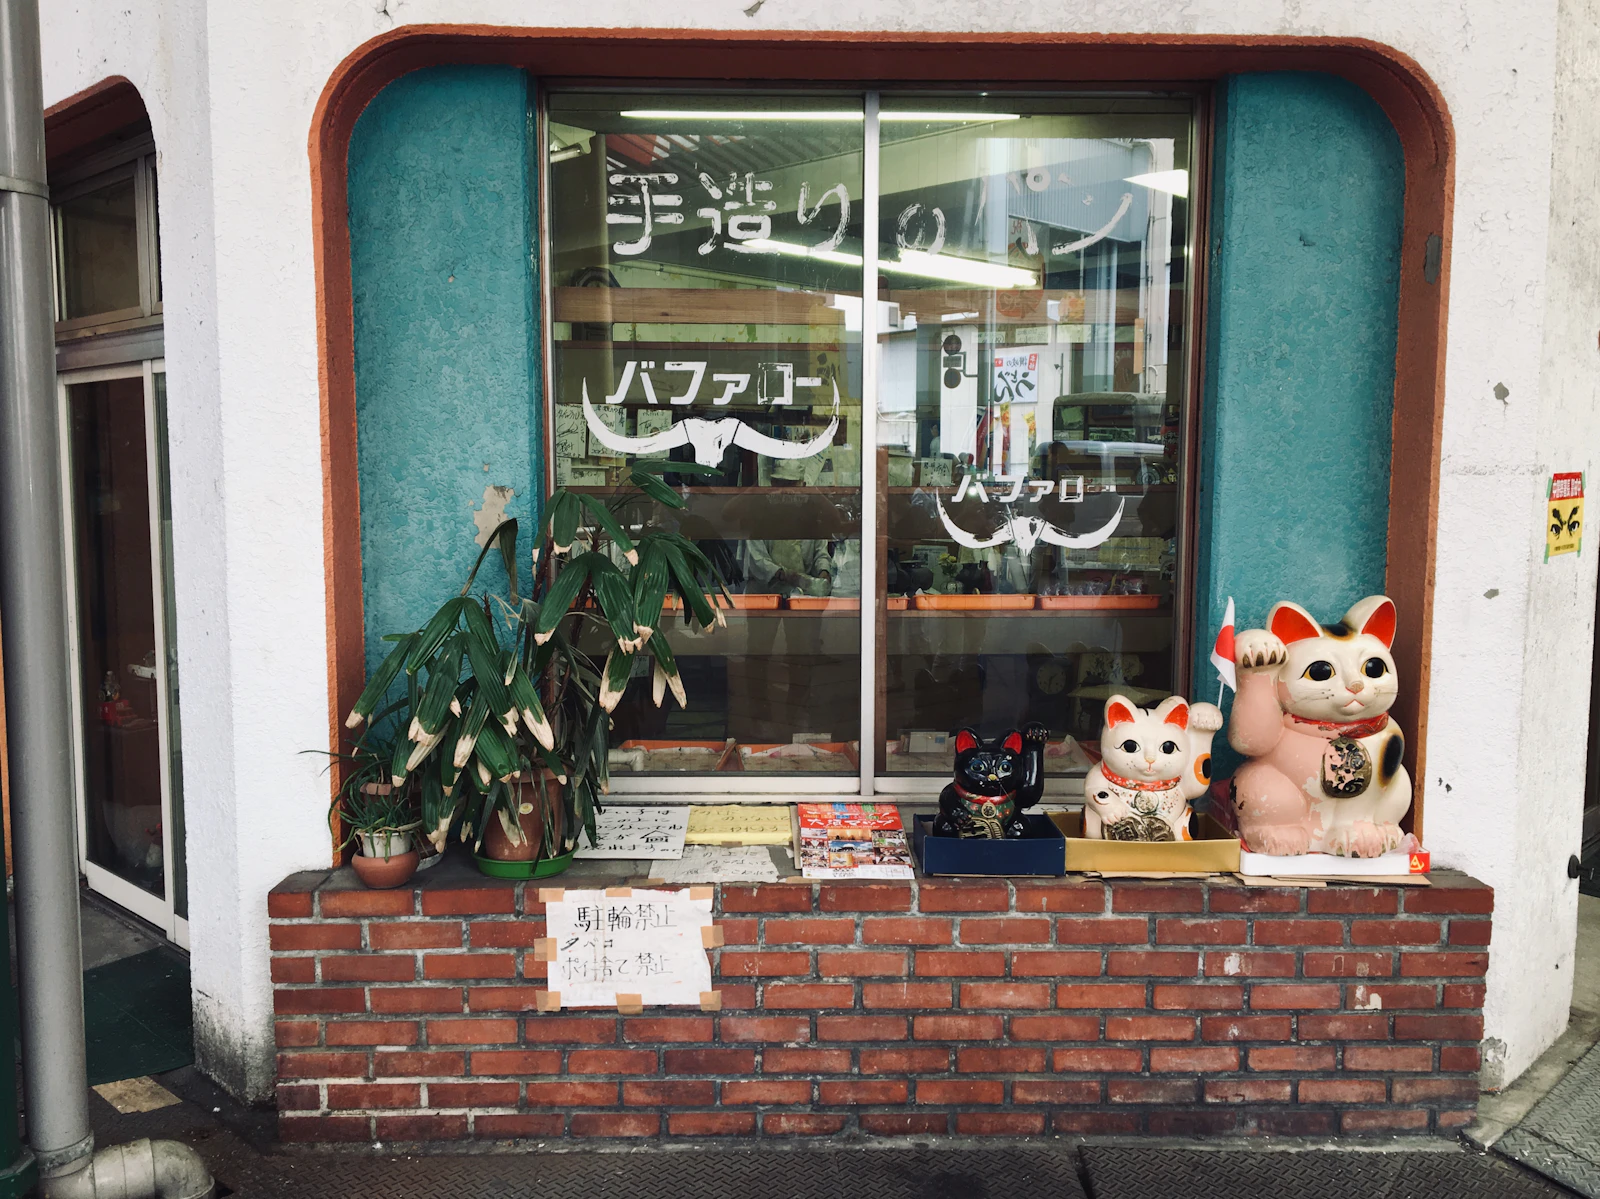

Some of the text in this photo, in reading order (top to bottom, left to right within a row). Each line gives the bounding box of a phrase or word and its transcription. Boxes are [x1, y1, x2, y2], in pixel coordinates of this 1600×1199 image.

[605, 361, 822, 405] バファロー
[951, 475, 1117, 503] バファロー
[574, 903, 677, 932] 駐輪禁止
[560, 937, 613, 951] タバコ
[562, 952, 674, 980] ポイ捨て禁止
